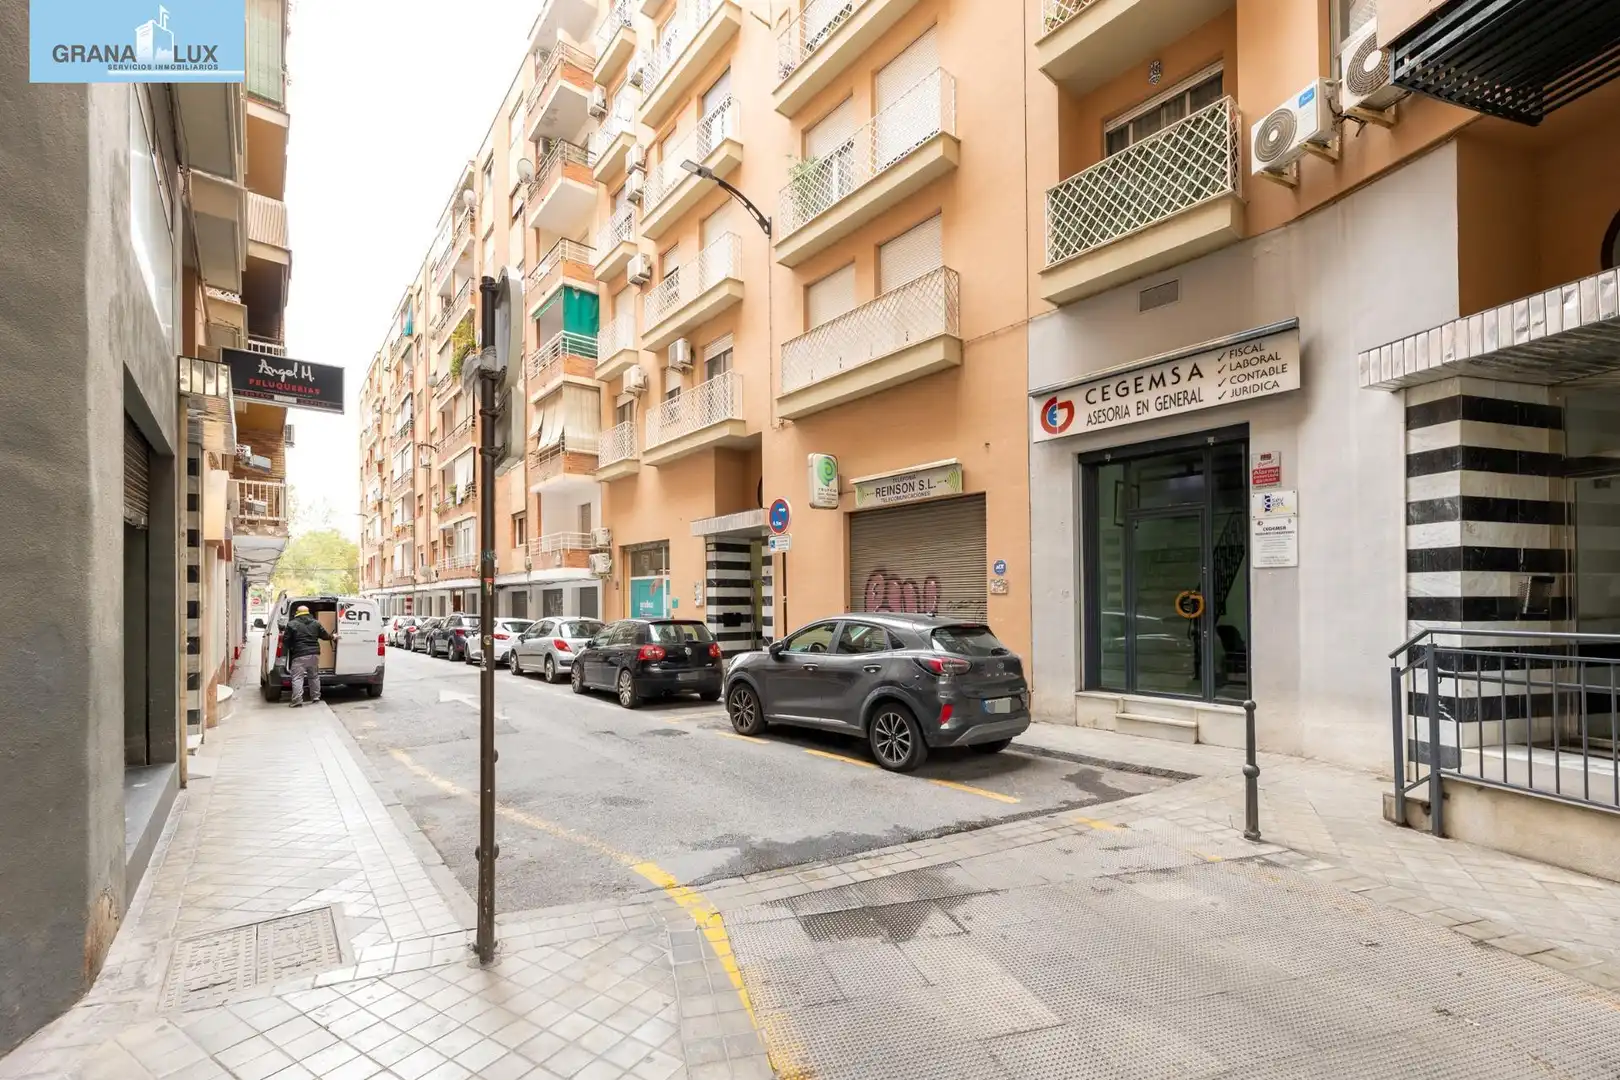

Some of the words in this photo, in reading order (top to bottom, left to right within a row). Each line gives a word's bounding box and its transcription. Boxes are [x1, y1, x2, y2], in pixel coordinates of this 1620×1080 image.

[1229, 342, 1266, 359] FISCAL
[257, 358, 298, 382] Angel
[1229, 352, 1282, 371] LABORAL
[1085, 362, 1204, 405] CEGEMSA
[1229, 363, 1288, 384] CONTABLE
[249, 378, 321, 395] PELUQUERIAS
[1230, 380, 1280, 398] JURIDICA
[1086, 406, 1131, 426] ASESORIA
[1136, 400, 1150, 416] EN
[1154, 387, 1204, 412] GENERAL
[875, 481, 915, 498] REINSON
[918, 478, 937, 491] S.L.
